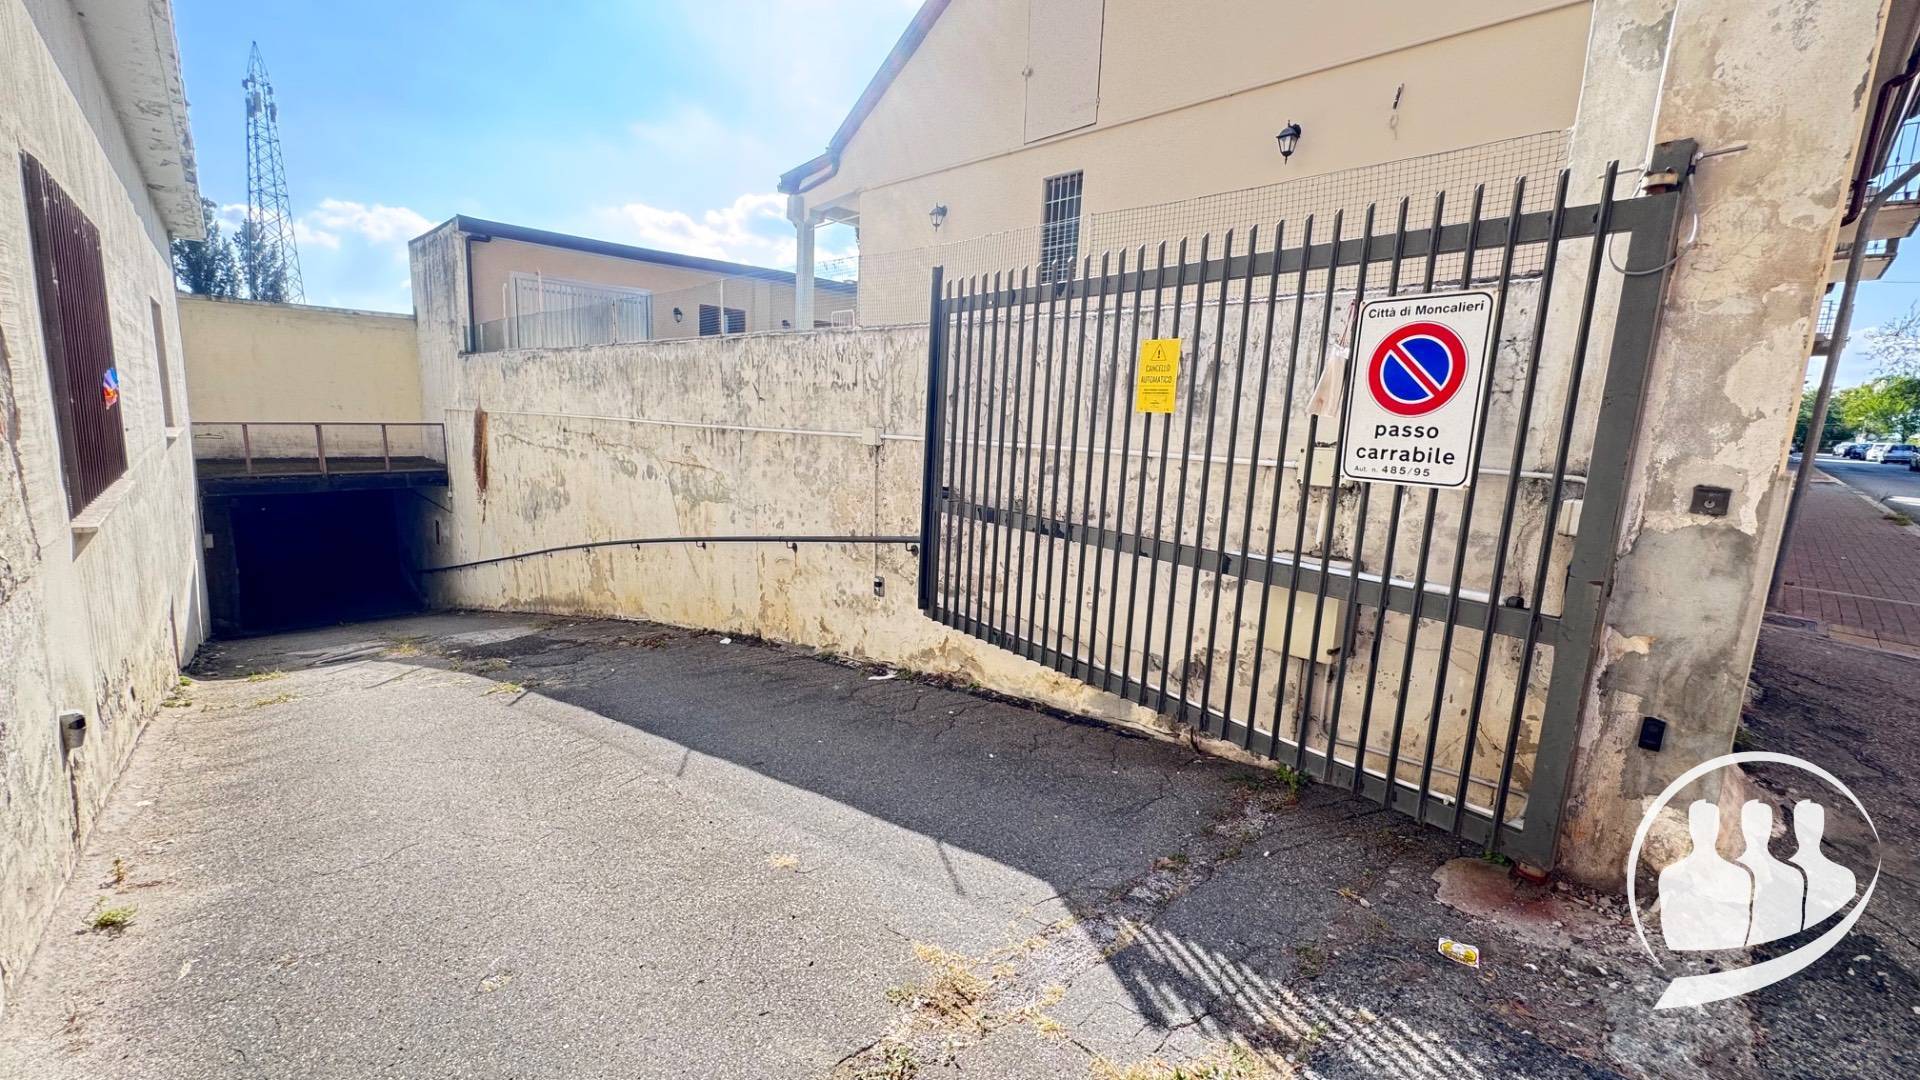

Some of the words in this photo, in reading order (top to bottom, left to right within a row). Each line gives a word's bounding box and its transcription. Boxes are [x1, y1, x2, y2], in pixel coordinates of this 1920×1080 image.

[1368, 307, 1396, 319] Città
[1400, 305, 1411, 317] di
[1415, 300, 1485, 315] Moncalieri
[1145, 364, 1171, 372] CANCELLO
[1374, 424, 1439, 439] passo
[1356, 446, 1455, 465] carrabile
[1354, 465, 1367, 473] Aut.
[1381, 465, 1430, 477] 485/95
